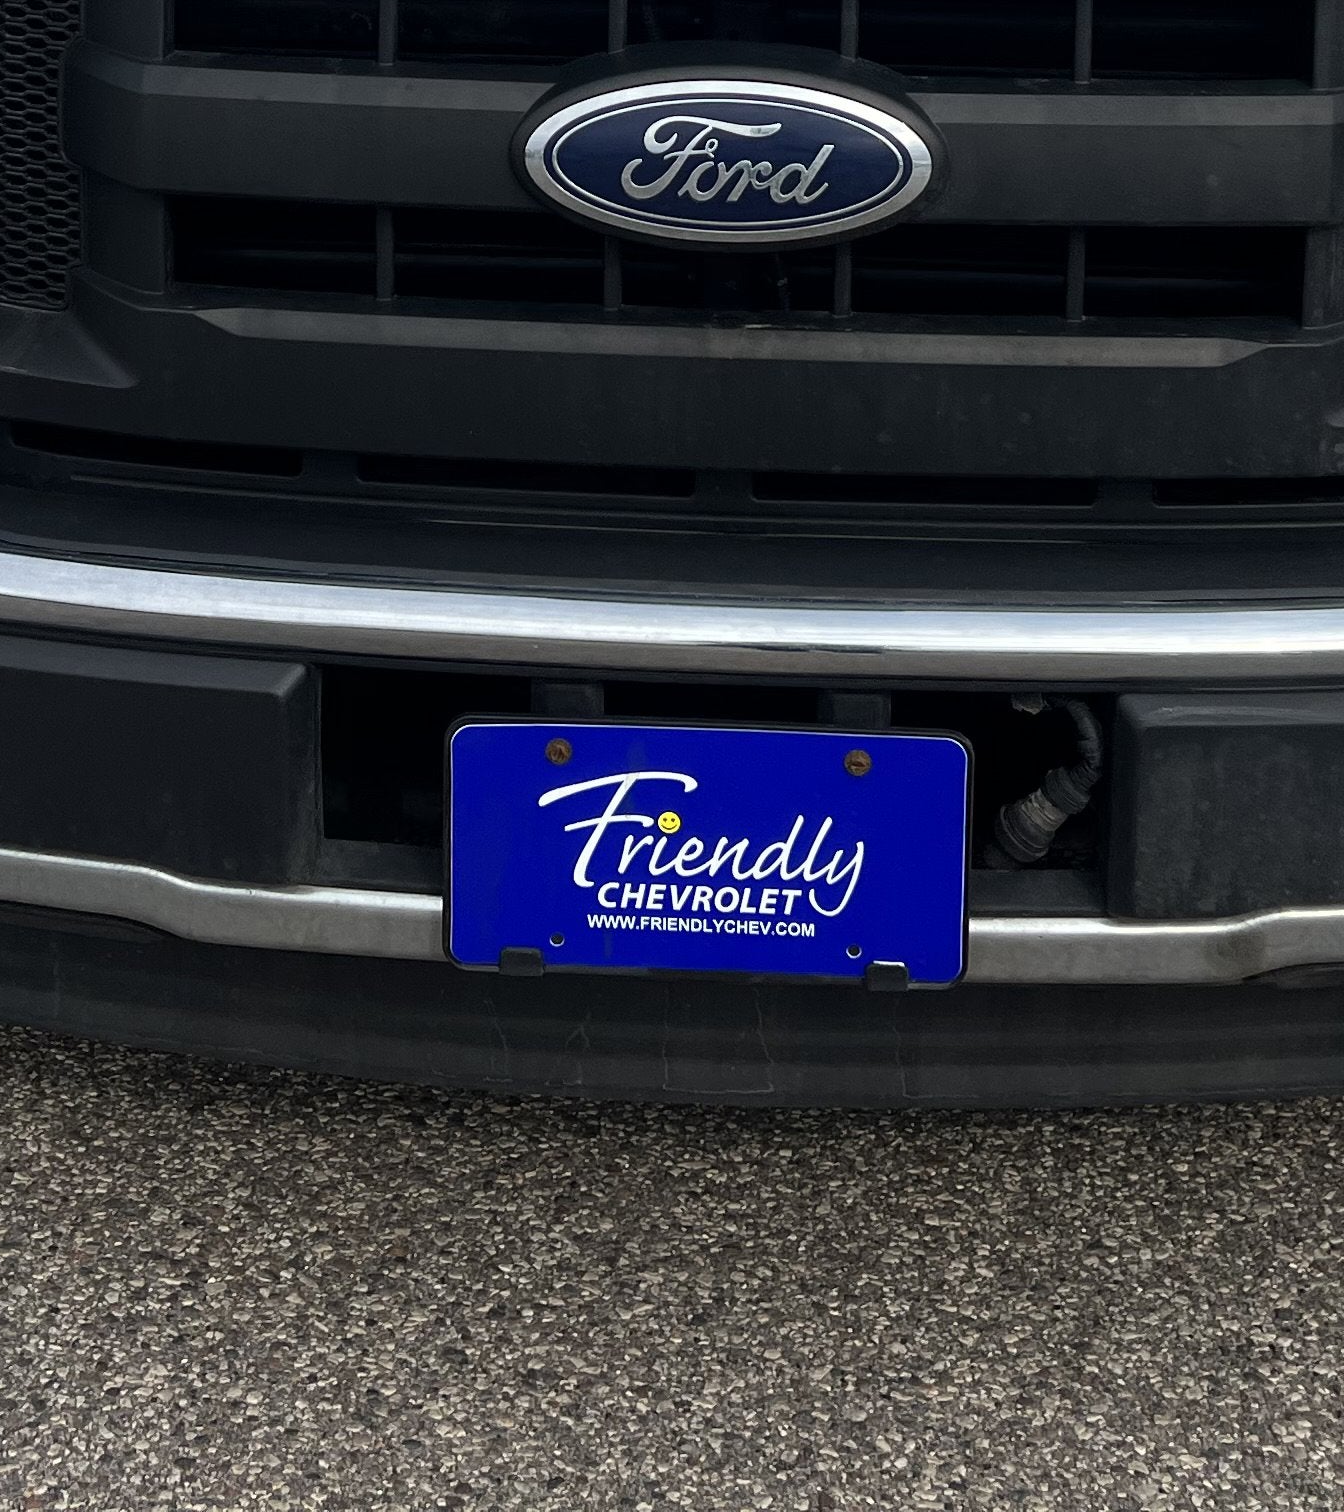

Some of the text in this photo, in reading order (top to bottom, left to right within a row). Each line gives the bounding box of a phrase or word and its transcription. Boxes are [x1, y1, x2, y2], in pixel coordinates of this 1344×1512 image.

[619, 114, 835, 205] Ford
[538, 769, 865, 917] Friendly
[587, 912, 816, 938] WWW.FRIENDLYCHEV.COM
[597, 881, 803, 916] CHEVROLET
